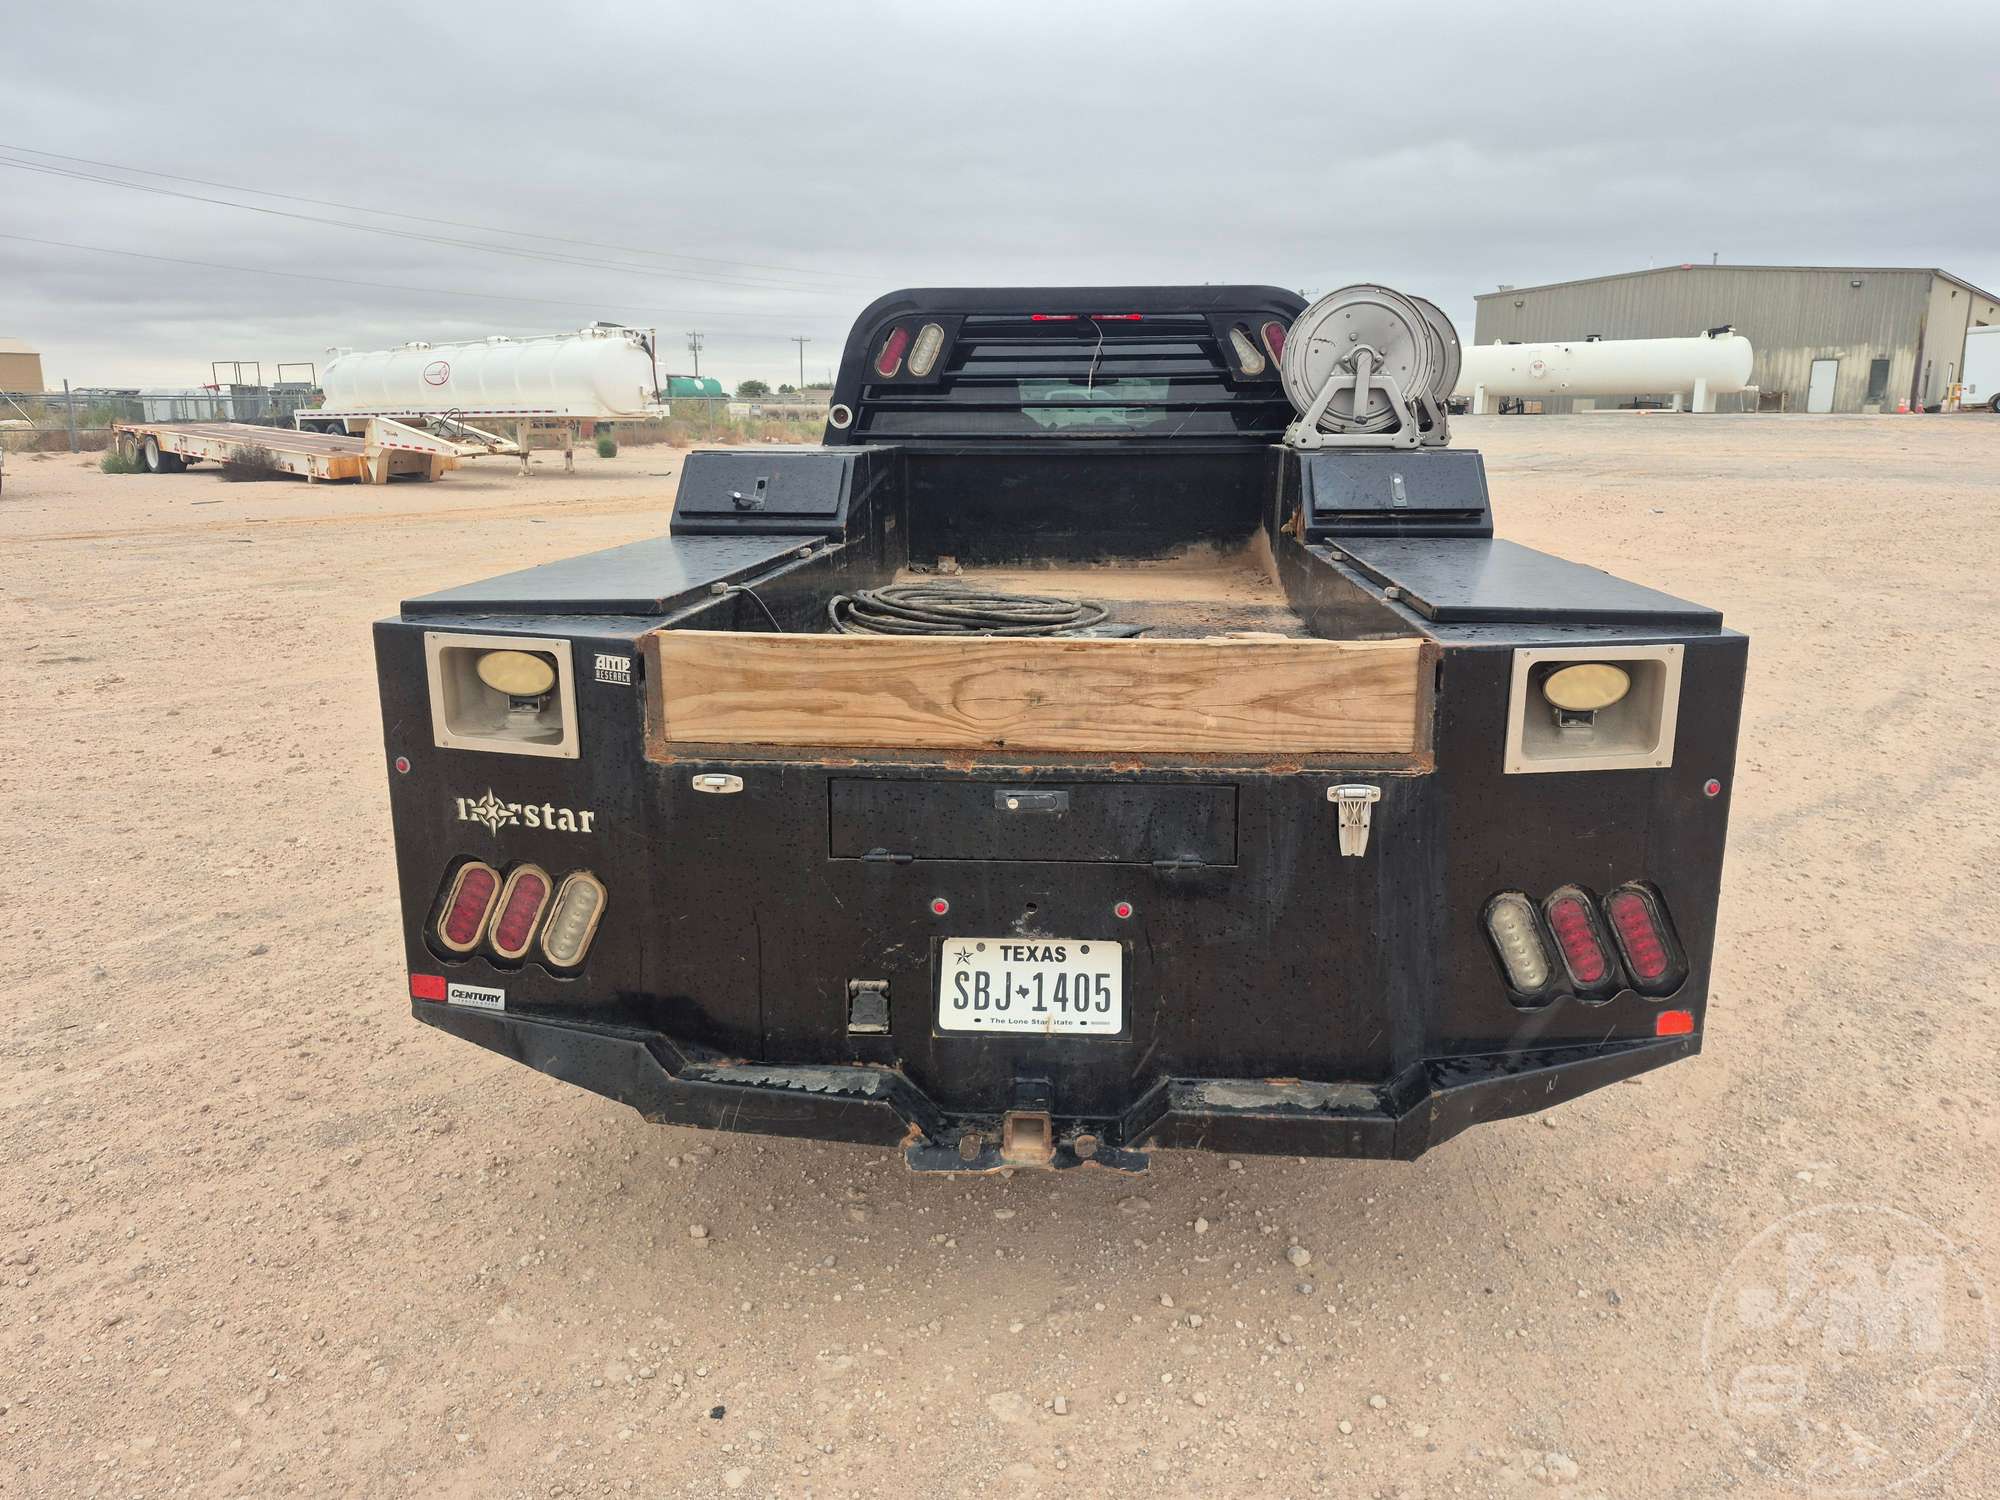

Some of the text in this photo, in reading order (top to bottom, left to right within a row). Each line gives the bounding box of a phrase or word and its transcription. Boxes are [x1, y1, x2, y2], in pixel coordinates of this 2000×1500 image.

[595, 670, 631, 683] RESEARCH
[1000, 945, 1067, 963] TEXAS
[451, 989, 501, 1003] CENTURY
[953, 970, 1111, 1013] SBJ 1405
[1008, 1018, 1028, 1026] Lone
